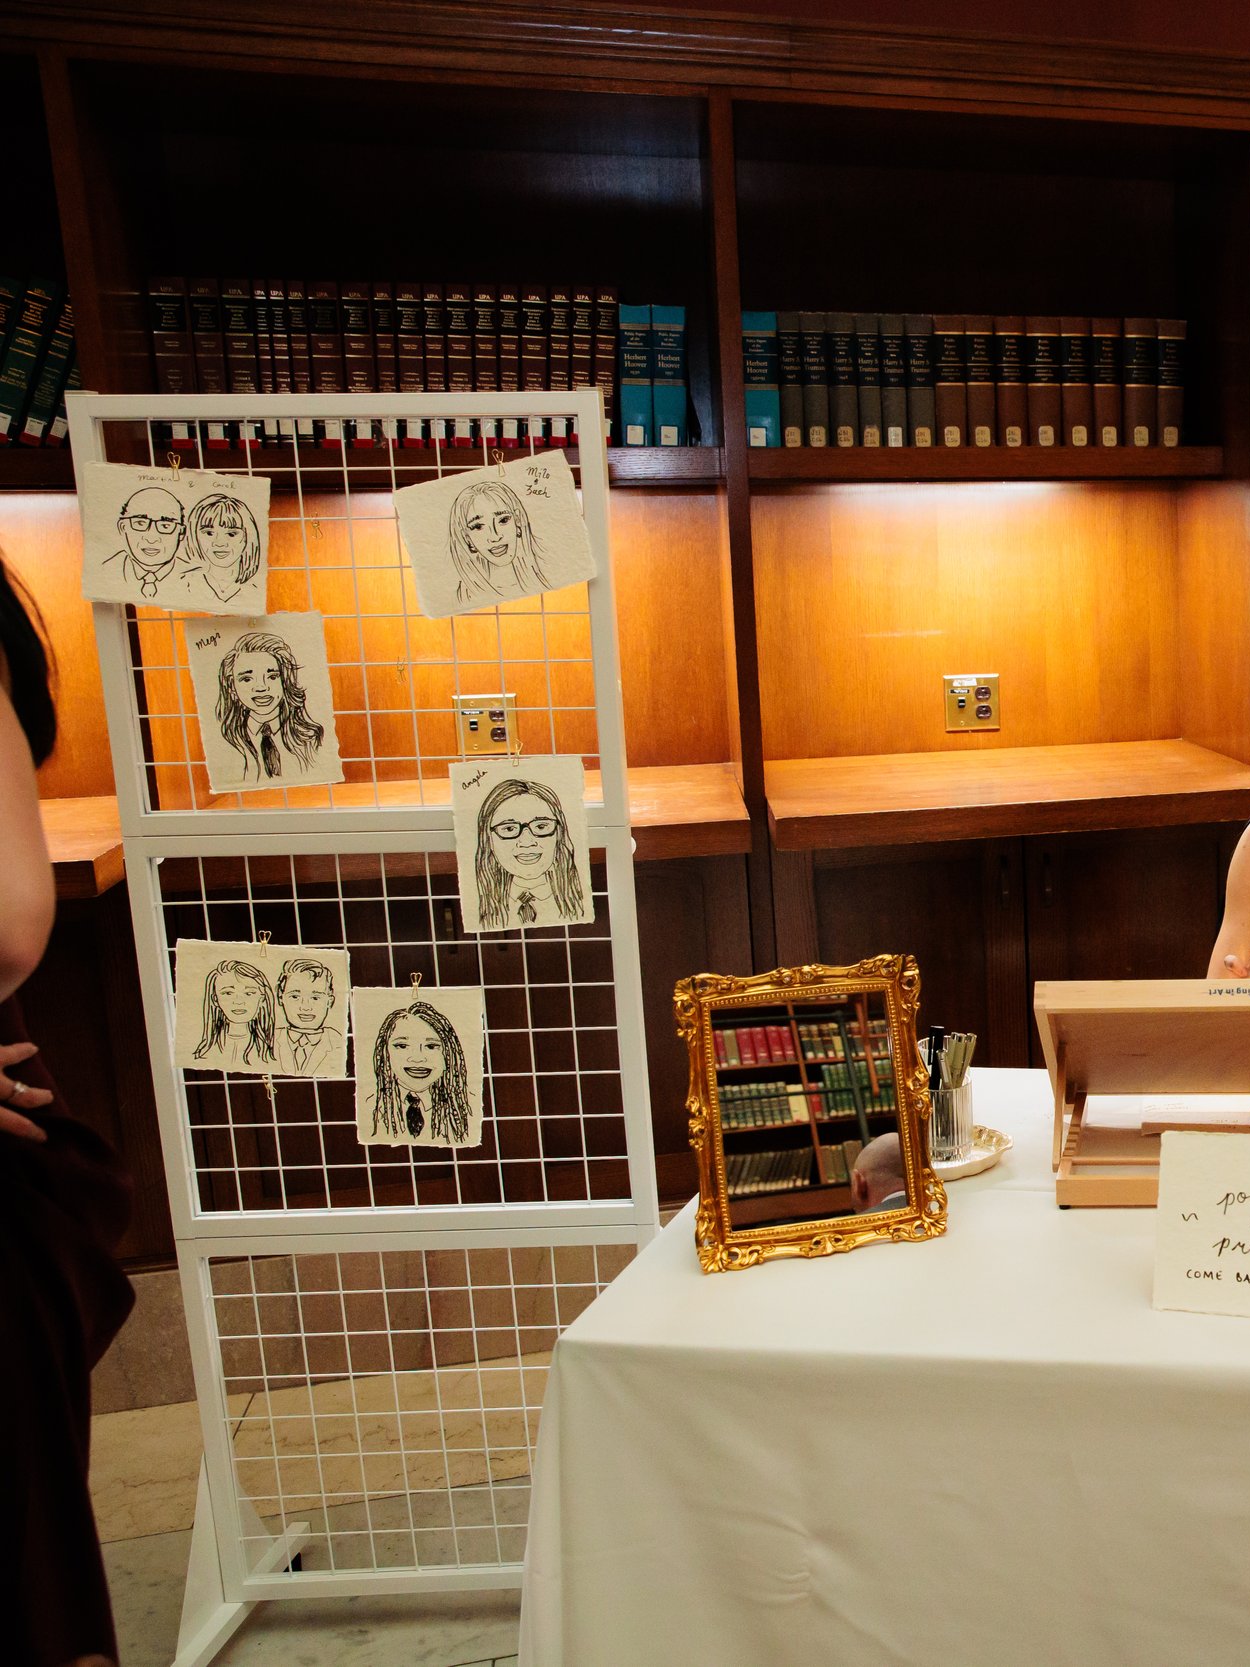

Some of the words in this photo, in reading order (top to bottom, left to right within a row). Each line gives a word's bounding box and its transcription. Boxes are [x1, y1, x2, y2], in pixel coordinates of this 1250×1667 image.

[624, 353, 647, 361] Herbert
[657, 353, 680, 362] Herbert
[624, 360, 647, 368] Hoover
[657, 361, 680, 369] Hoover
[745, 359, 768, 367] Herbert
[1186, 1268, 1223, 1281] COME
